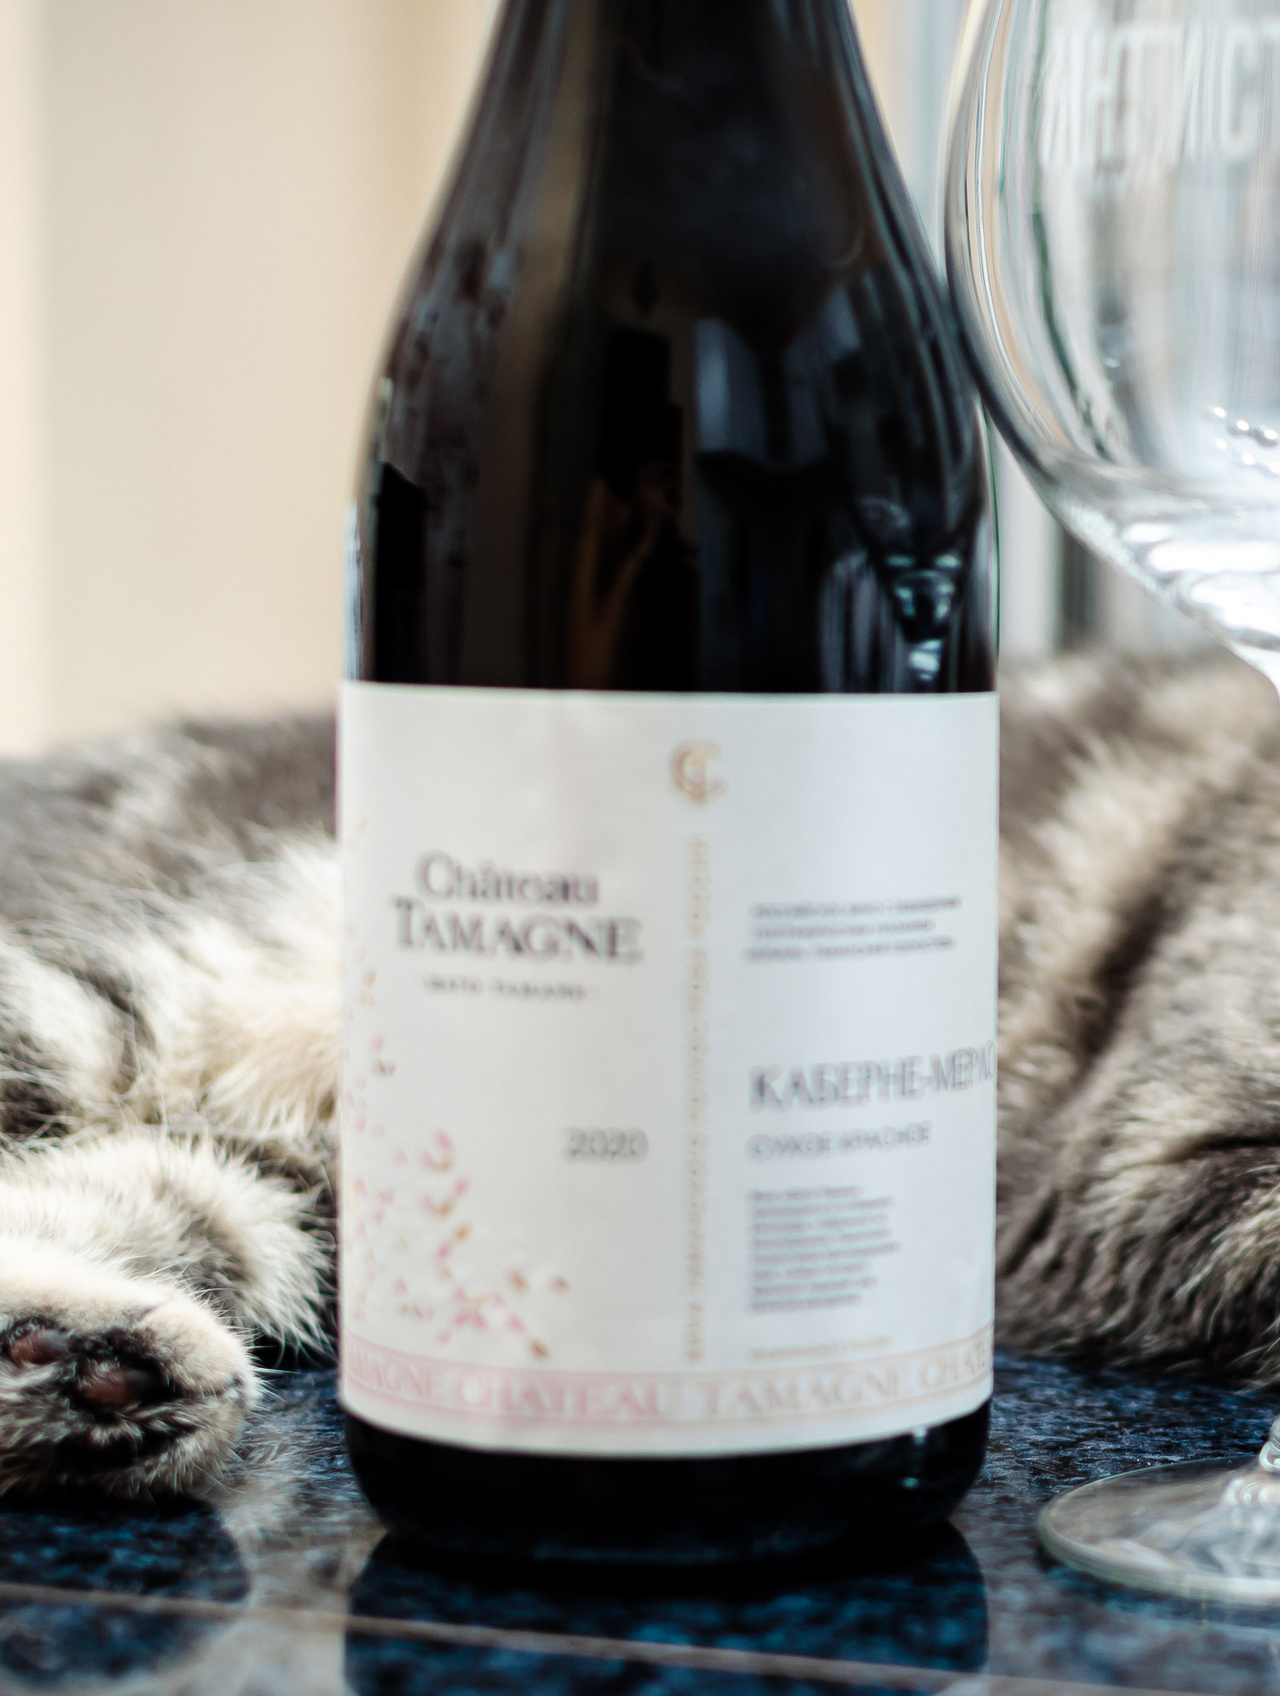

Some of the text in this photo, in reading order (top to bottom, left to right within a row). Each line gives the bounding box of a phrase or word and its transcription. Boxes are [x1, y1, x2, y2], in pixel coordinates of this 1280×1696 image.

[414, 850, 600, 905] Château
[390, 894, 645, 966] TAMAGNE
[563, 1126, 650, 1163] 2020
